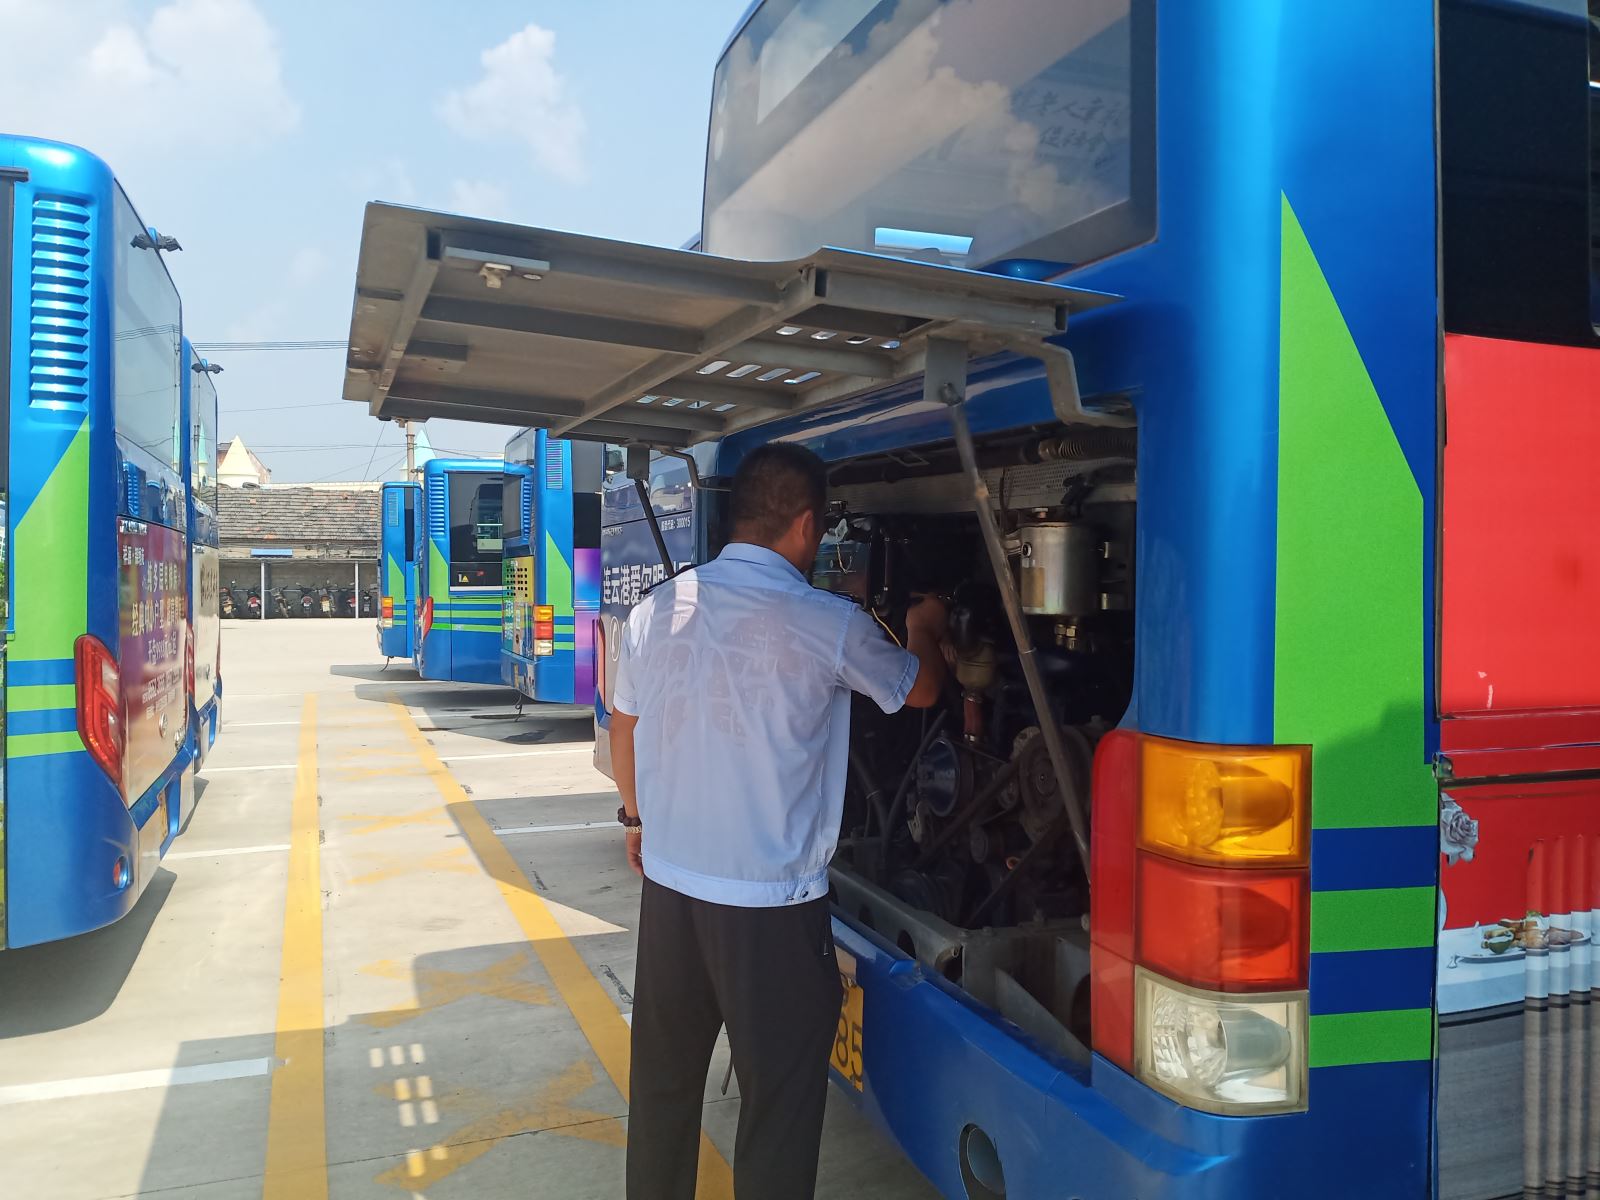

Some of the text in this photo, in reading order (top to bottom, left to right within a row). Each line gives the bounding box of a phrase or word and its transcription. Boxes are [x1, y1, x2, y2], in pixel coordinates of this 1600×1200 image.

[603, 562, 692, 606] 连云港爱尔眼
